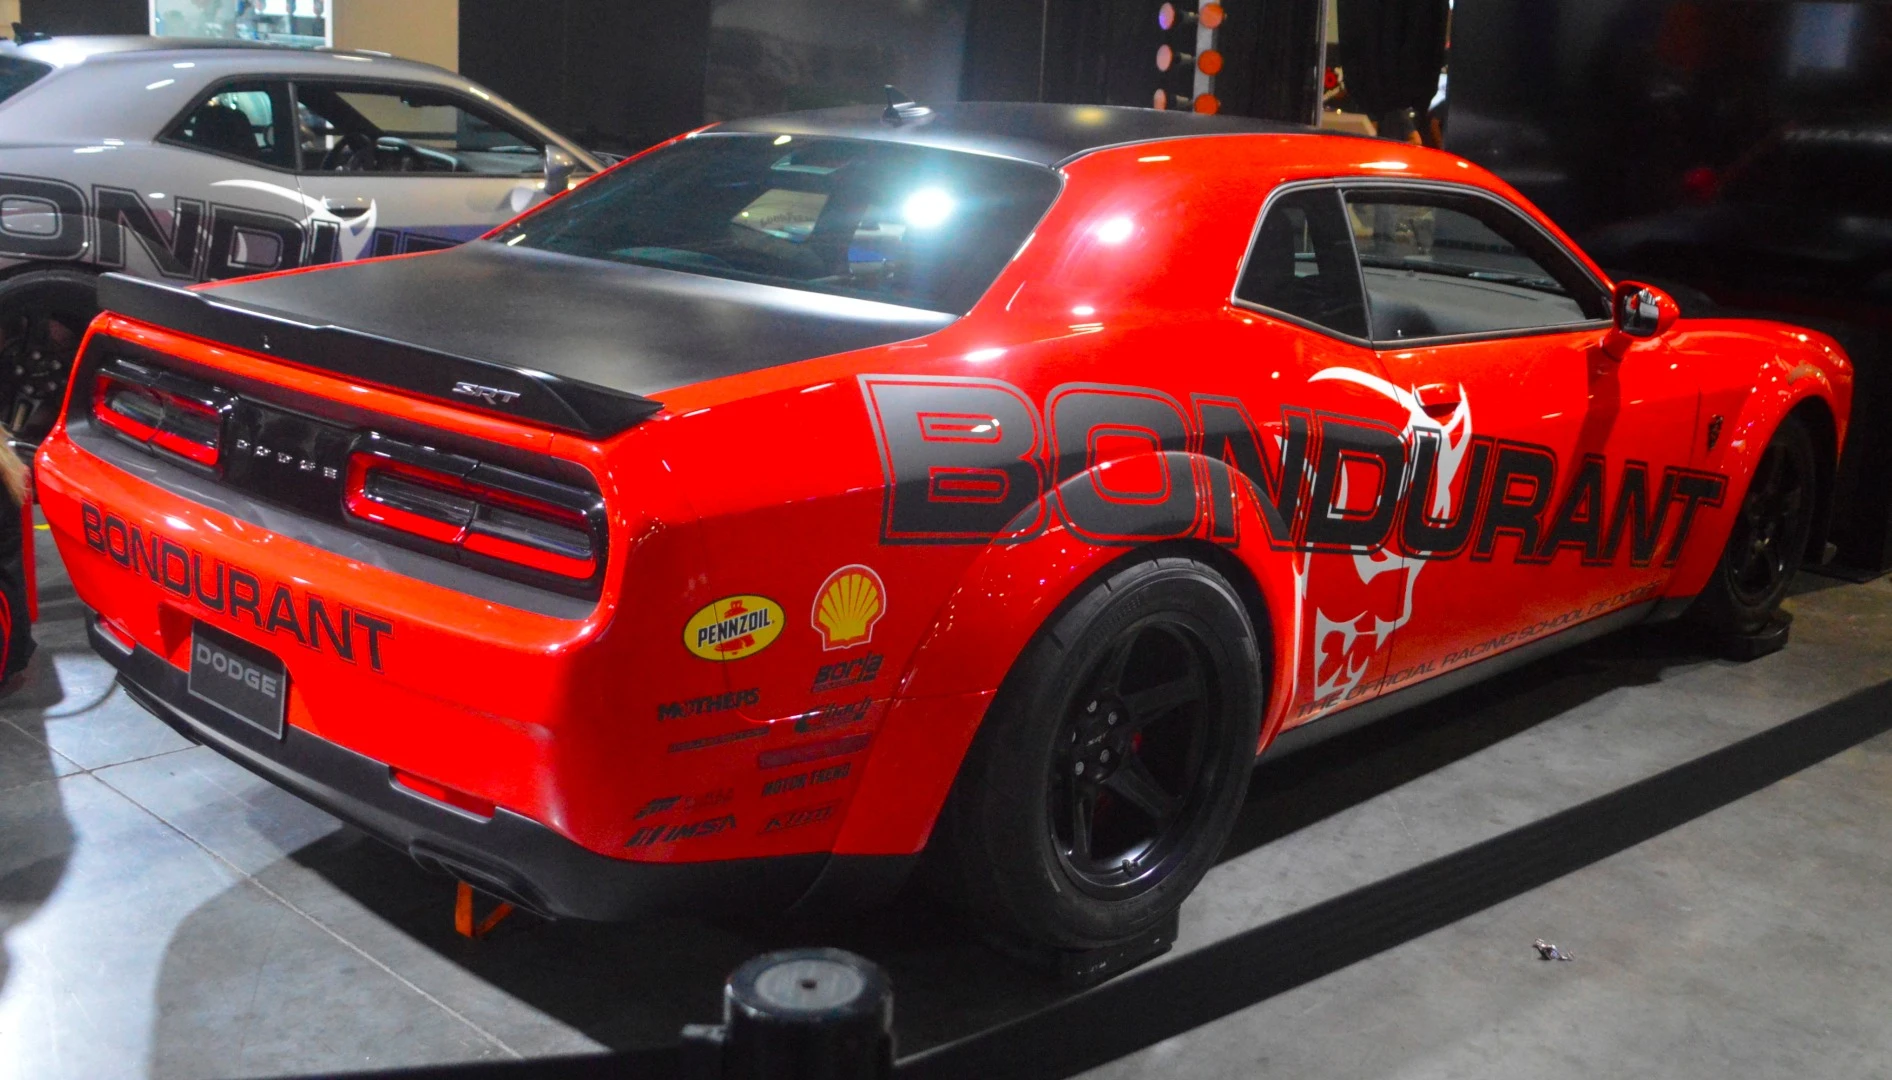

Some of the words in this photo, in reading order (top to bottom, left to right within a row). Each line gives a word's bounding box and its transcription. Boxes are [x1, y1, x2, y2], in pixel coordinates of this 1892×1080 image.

[452, 381, 521, 405] SRT
[236, 438, 338, 480] DODGE
[857, 373, 1728, 570] BONDURANT
[82, 500, 396, 674] BONDURANT
[696, 607, 771, 648] PENNZOIL
[196, 642, 278, 700] DODGE
[1297, 687, 1345, 718] THE
[1345, 659, 1437, 701] OFFICIAL
[1441, 631, 1518, 668] RACING
[1517, 608, 1584, 641] SCHOOL
[663, 813, 736, 843] IMSA
